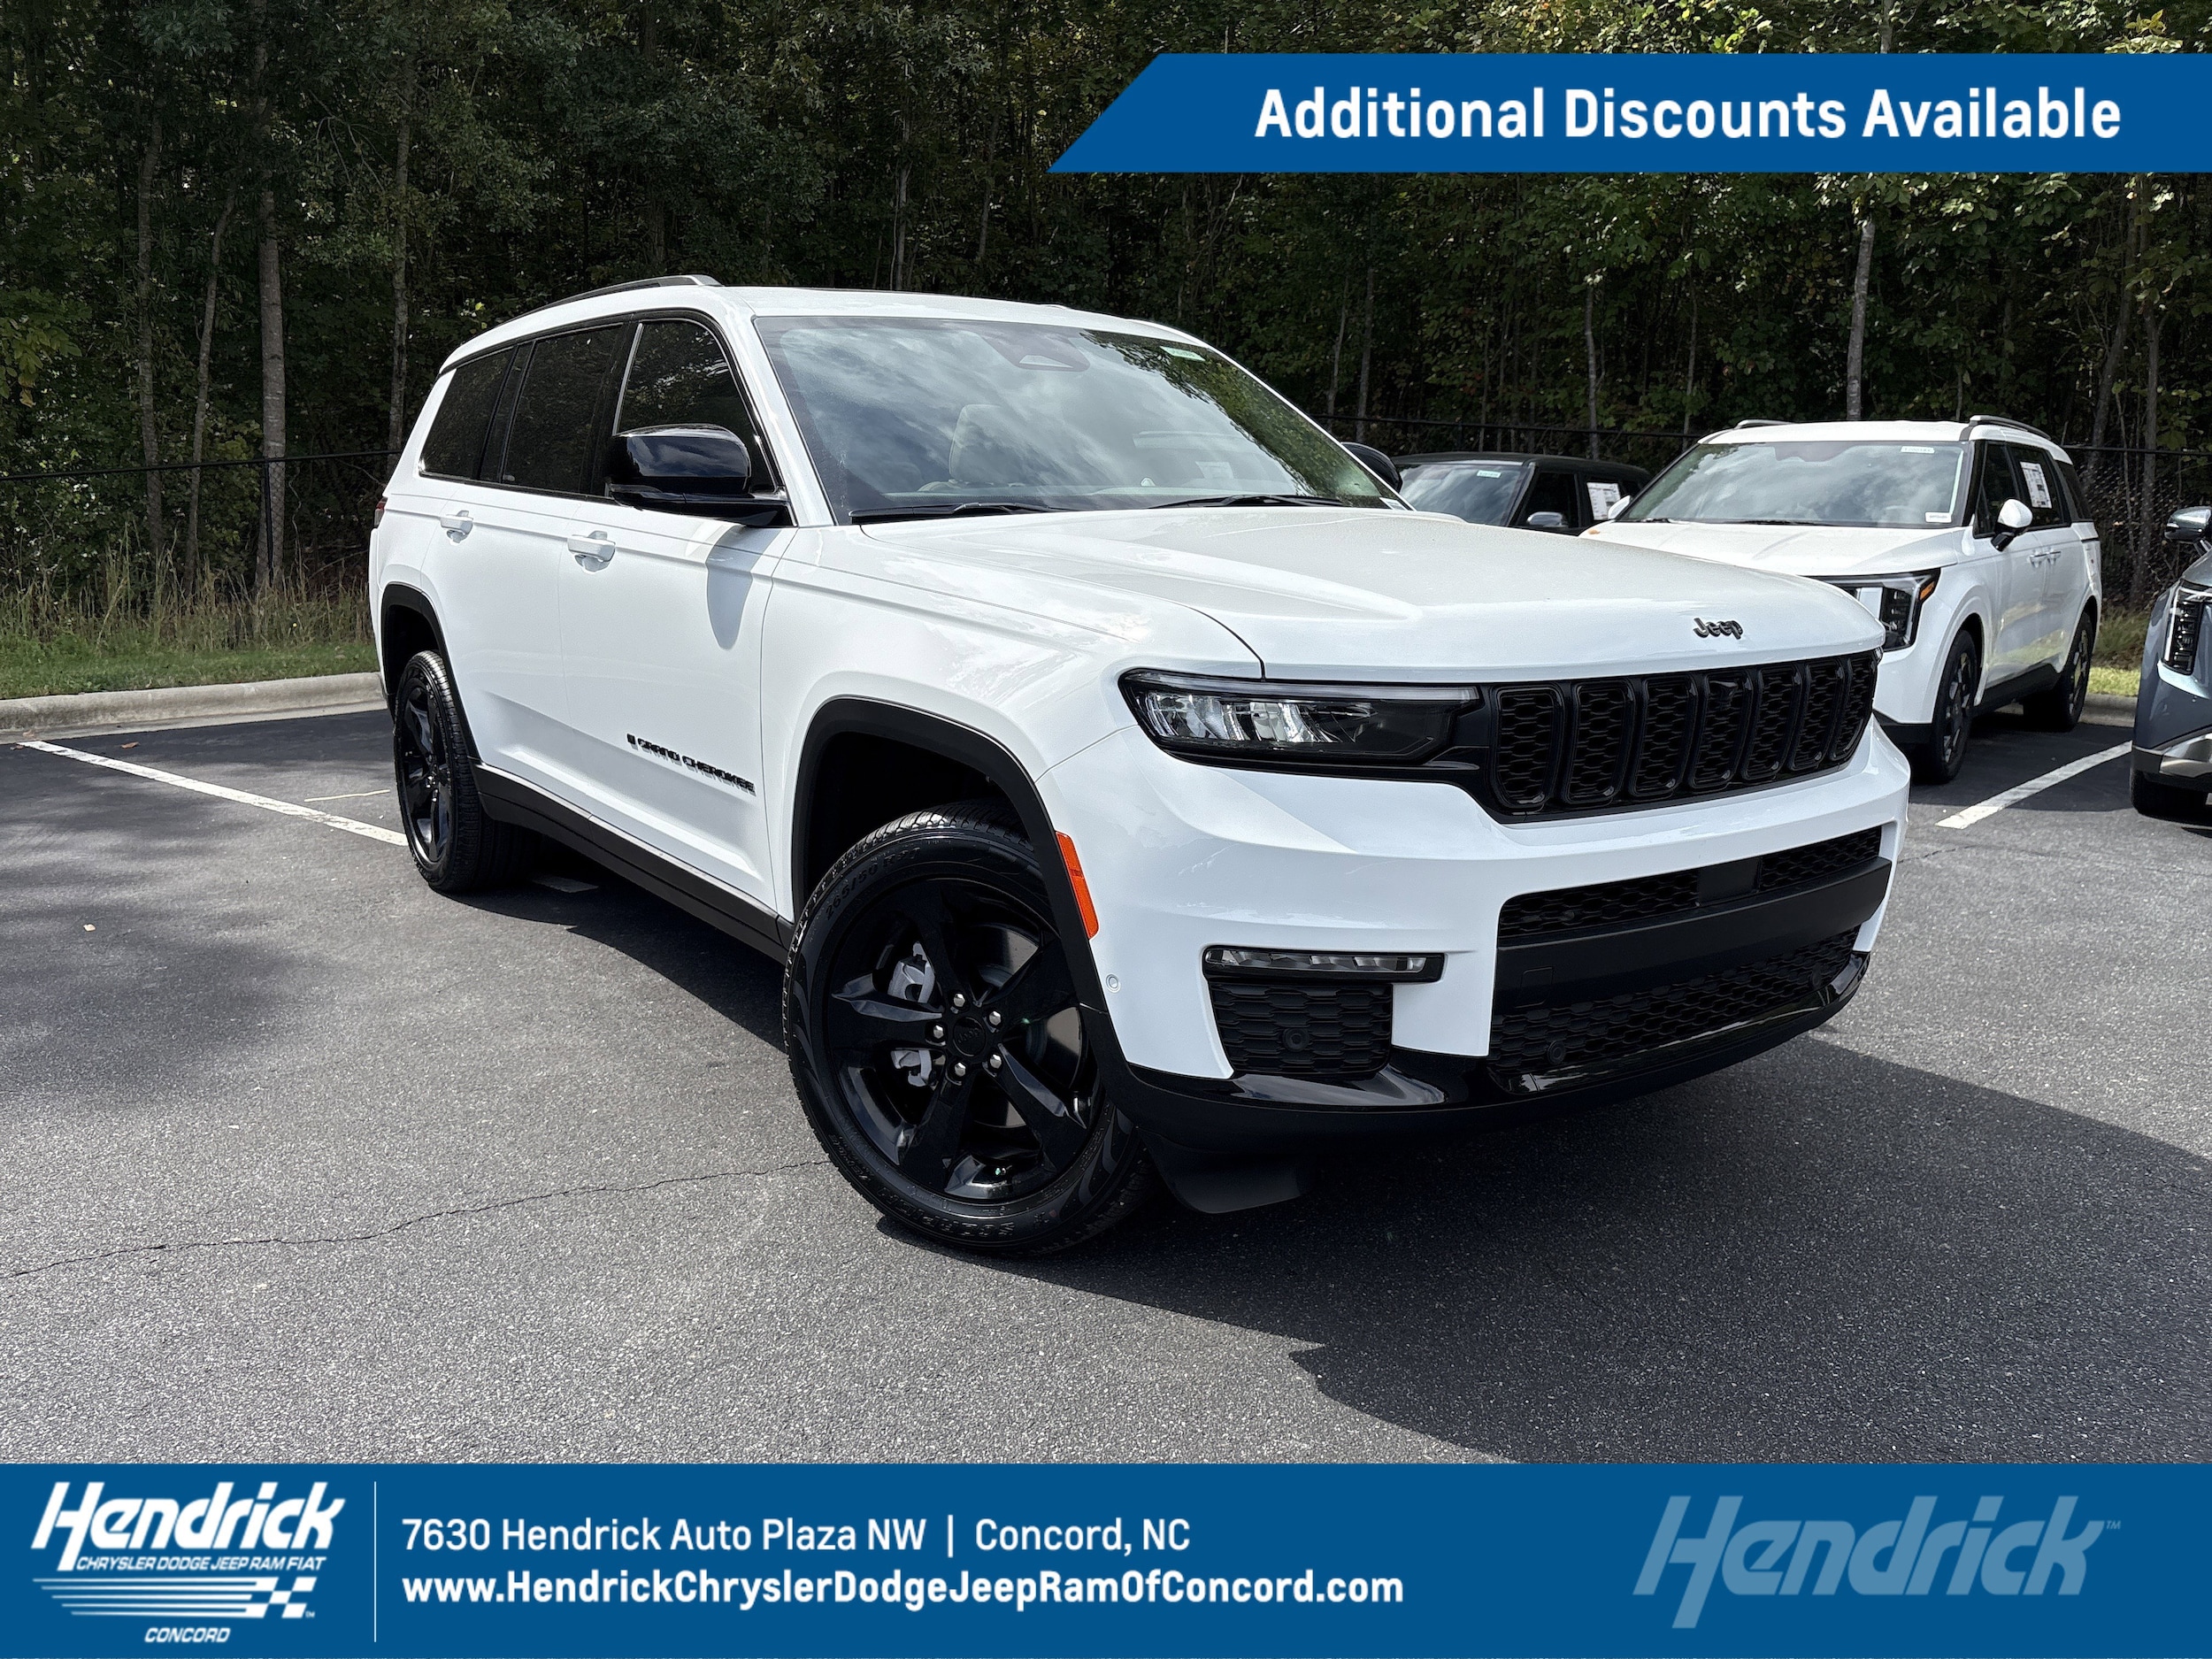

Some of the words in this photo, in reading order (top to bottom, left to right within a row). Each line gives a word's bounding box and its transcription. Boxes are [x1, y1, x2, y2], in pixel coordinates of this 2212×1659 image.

[1693, 618, 1743, 640] Jeep
[637, 738, 680, 761] GRAND
[681, 755, 756, 793] CHEROKEE
